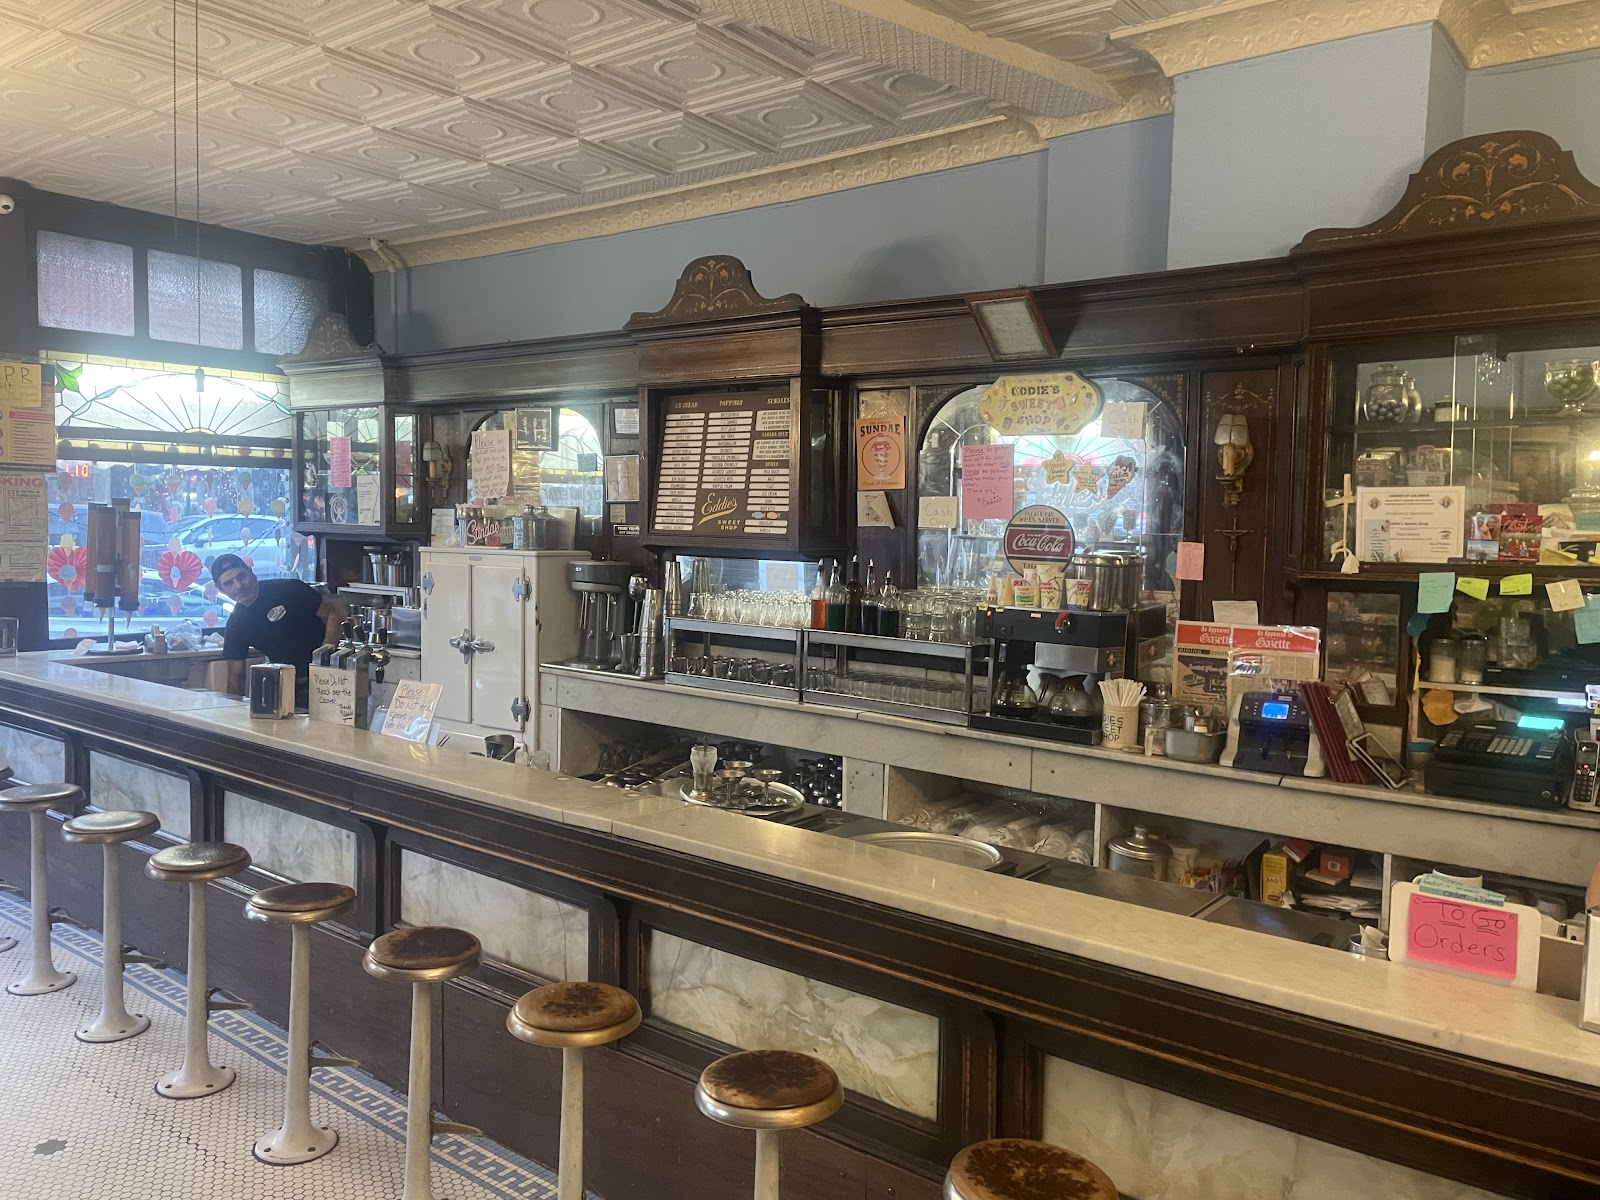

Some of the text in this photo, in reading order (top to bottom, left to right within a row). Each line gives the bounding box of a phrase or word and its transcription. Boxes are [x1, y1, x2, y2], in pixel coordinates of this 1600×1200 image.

[1110, 410, 1138, 424] Cash
[860, 424, 900, 437] SUNDAE
[474, 435, 494, 448] Please
[702, 492, 738, 516] Eddie's
[925, 502, 952, 516] Cash
[1013, 534, 1066, 552] Coca-Cola
[1200, 632, 1230, 645] Gazett
[1256, 637, 1291, 650] Gazette
[314, 674, 330, 686] Please
[342, 688, 351, 696] the
[400, 685, 422, 696] Please
[395, 699, 404, 709] Do
[1414, 924, 1505, 962] Orders
